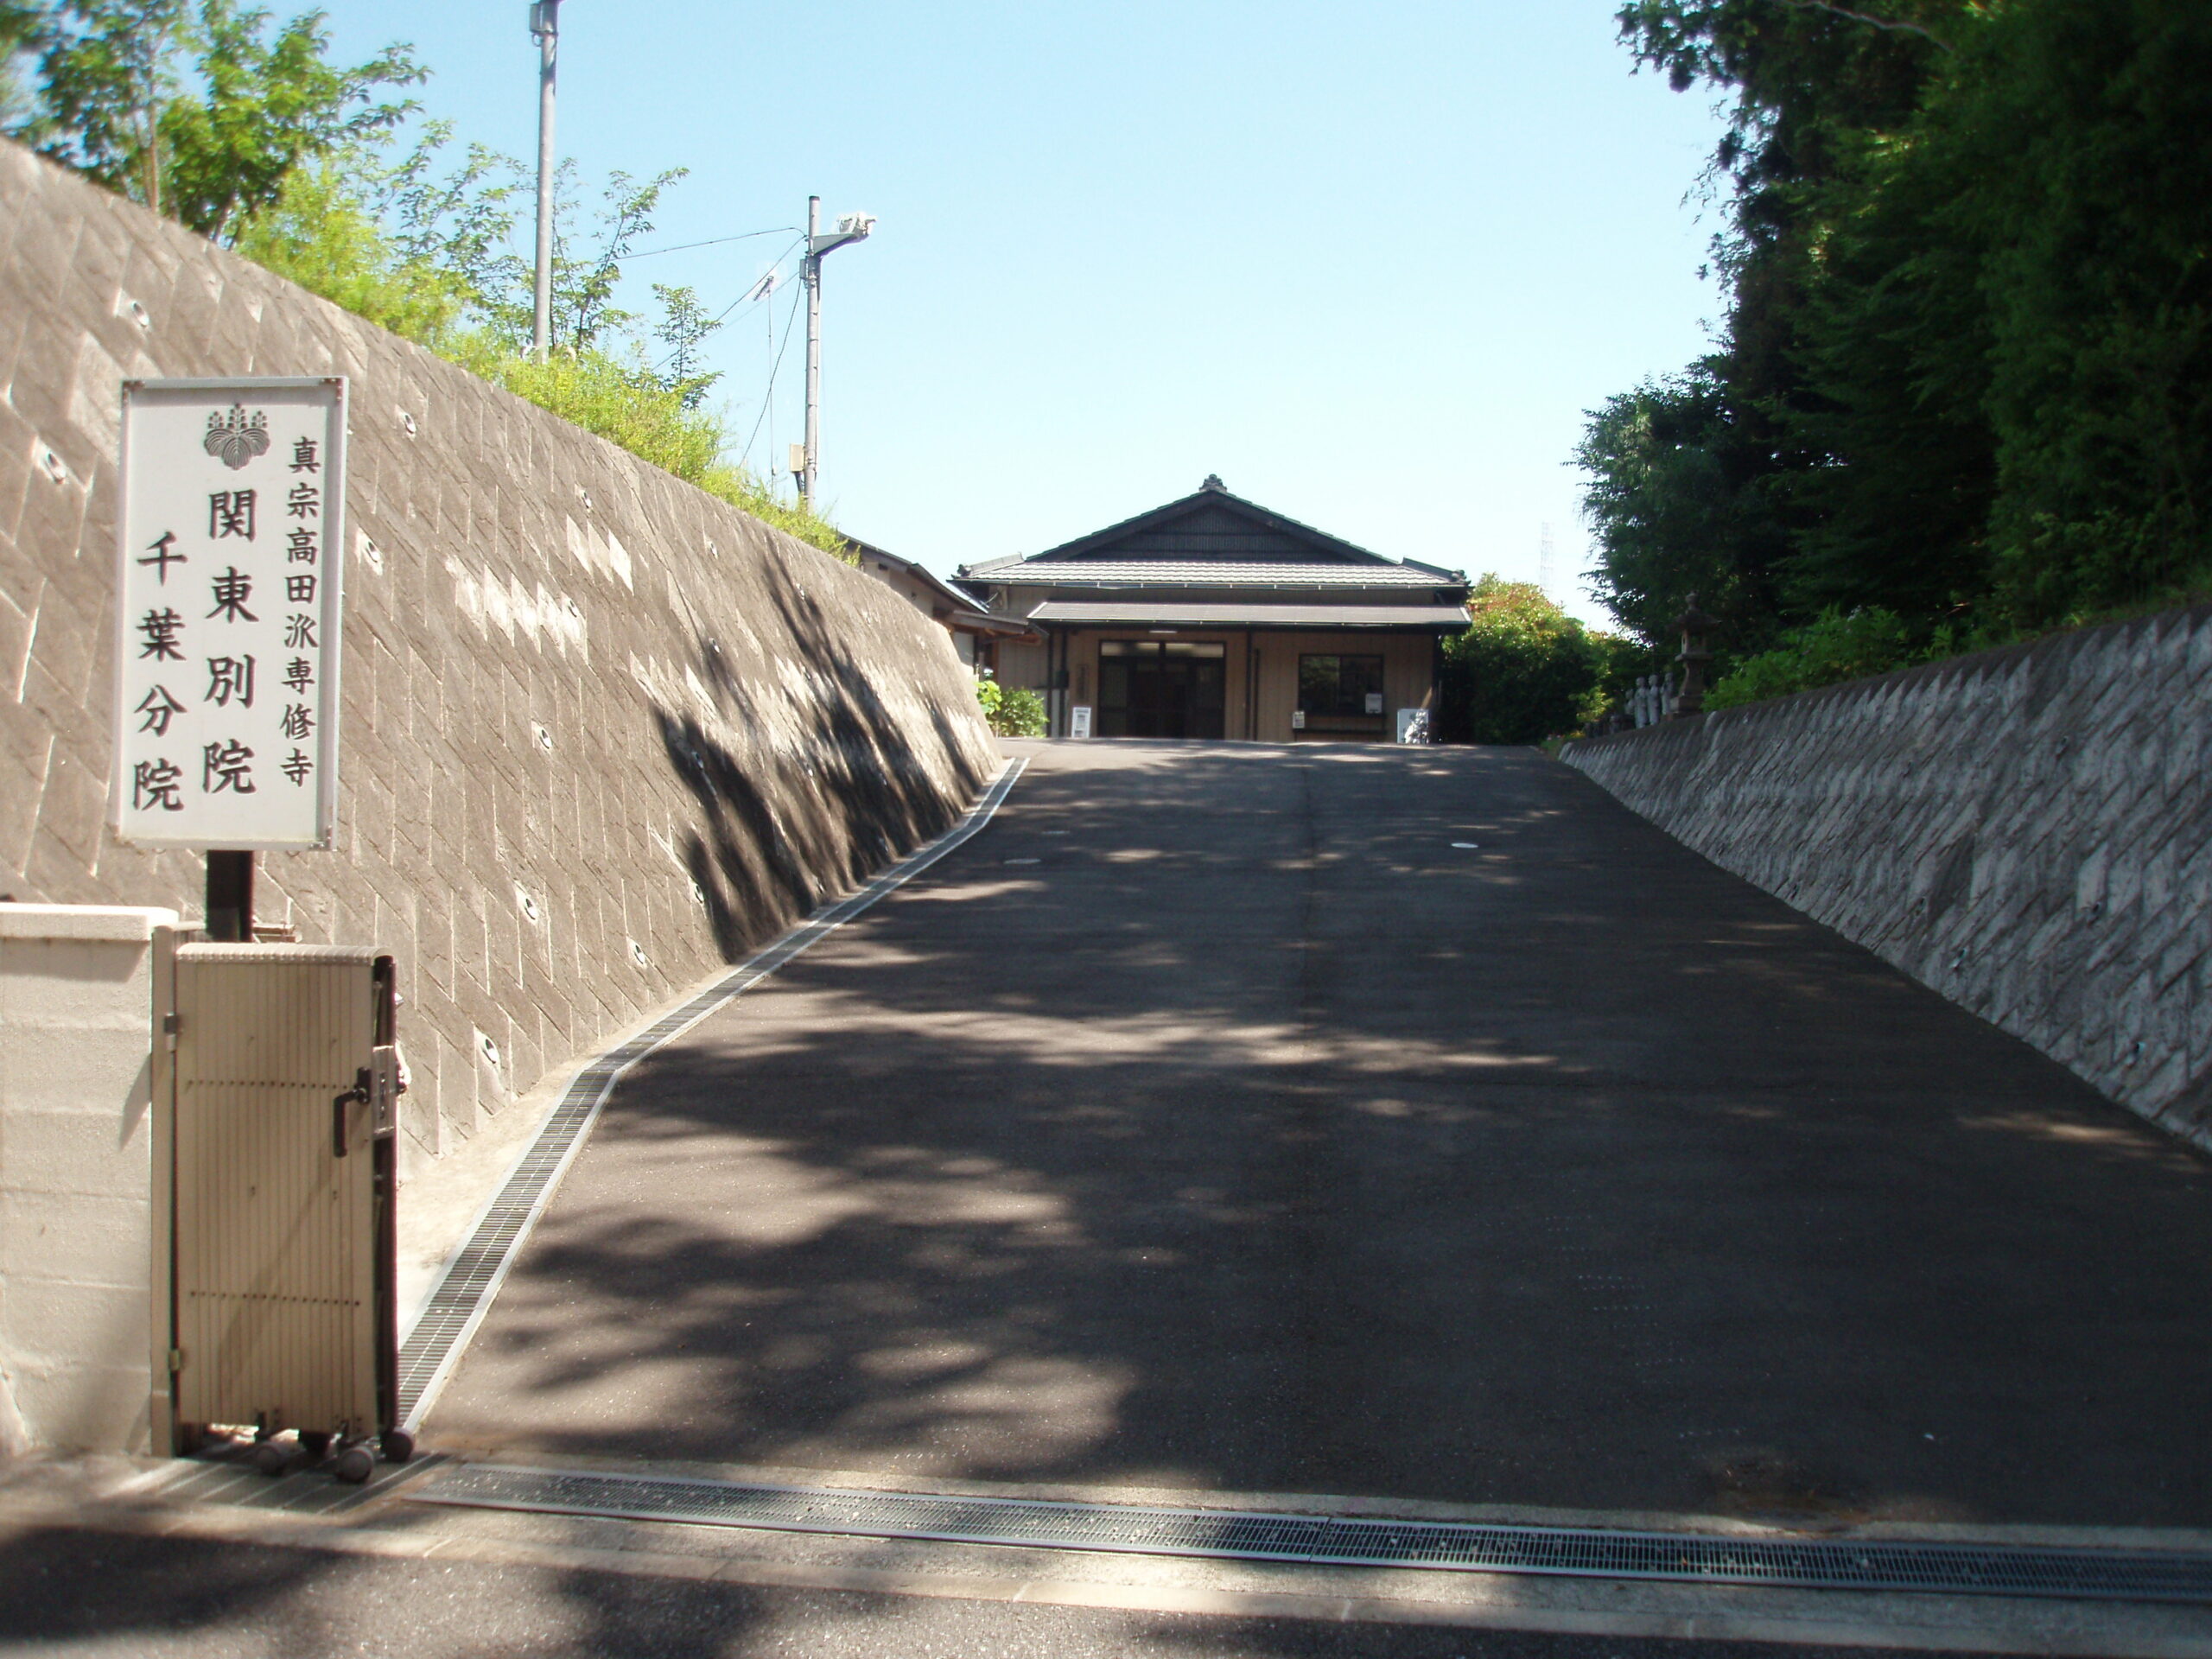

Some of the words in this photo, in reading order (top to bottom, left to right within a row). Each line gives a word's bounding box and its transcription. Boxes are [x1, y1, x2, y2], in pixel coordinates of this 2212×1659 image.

[132, 531, 188, 811] 千葉分院
[202, 488, 258, 794] 関東別院
